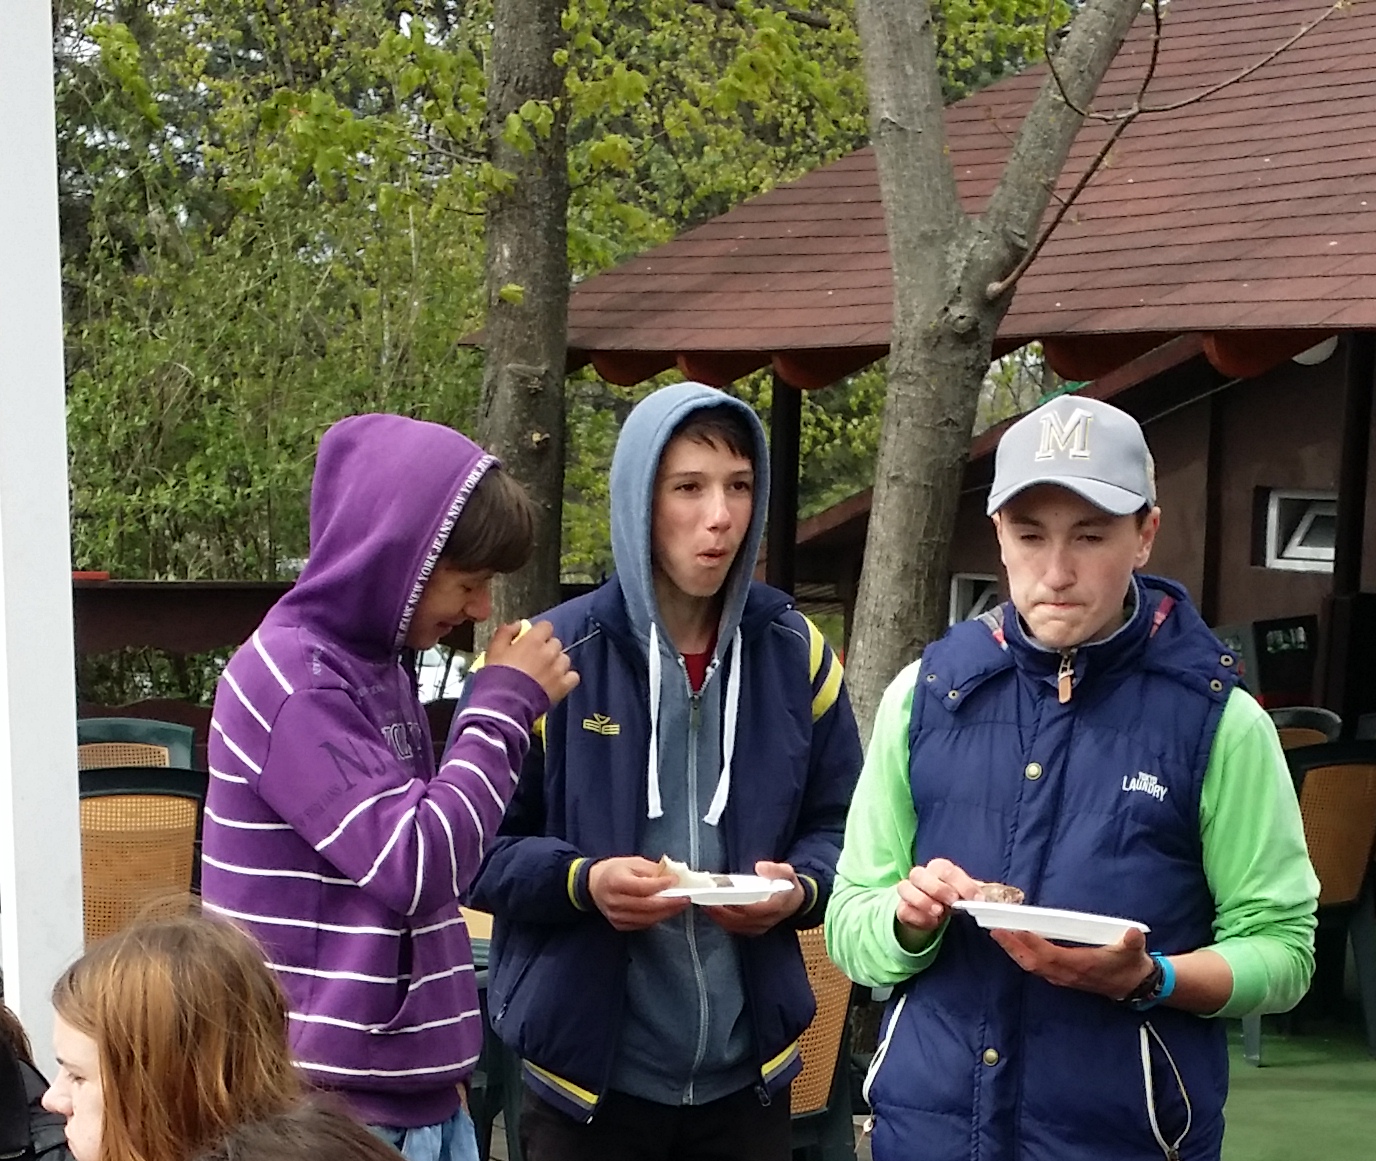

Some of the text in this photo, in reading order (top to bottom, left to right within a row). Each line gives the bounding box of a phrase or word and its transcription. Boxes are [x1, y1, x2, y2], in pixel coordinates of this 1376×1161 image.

[1035, 408, 1093, 461] M
[408, 581, 425, 605] NEW
[418, 552, 440, 582] YORK
[432, 518, 456, 553] JEANS
[447, 494, 467, 520] NEW
[460, 468, 482, 496] YORK
[1122, 775, 1168, 802] LAUNDRY
